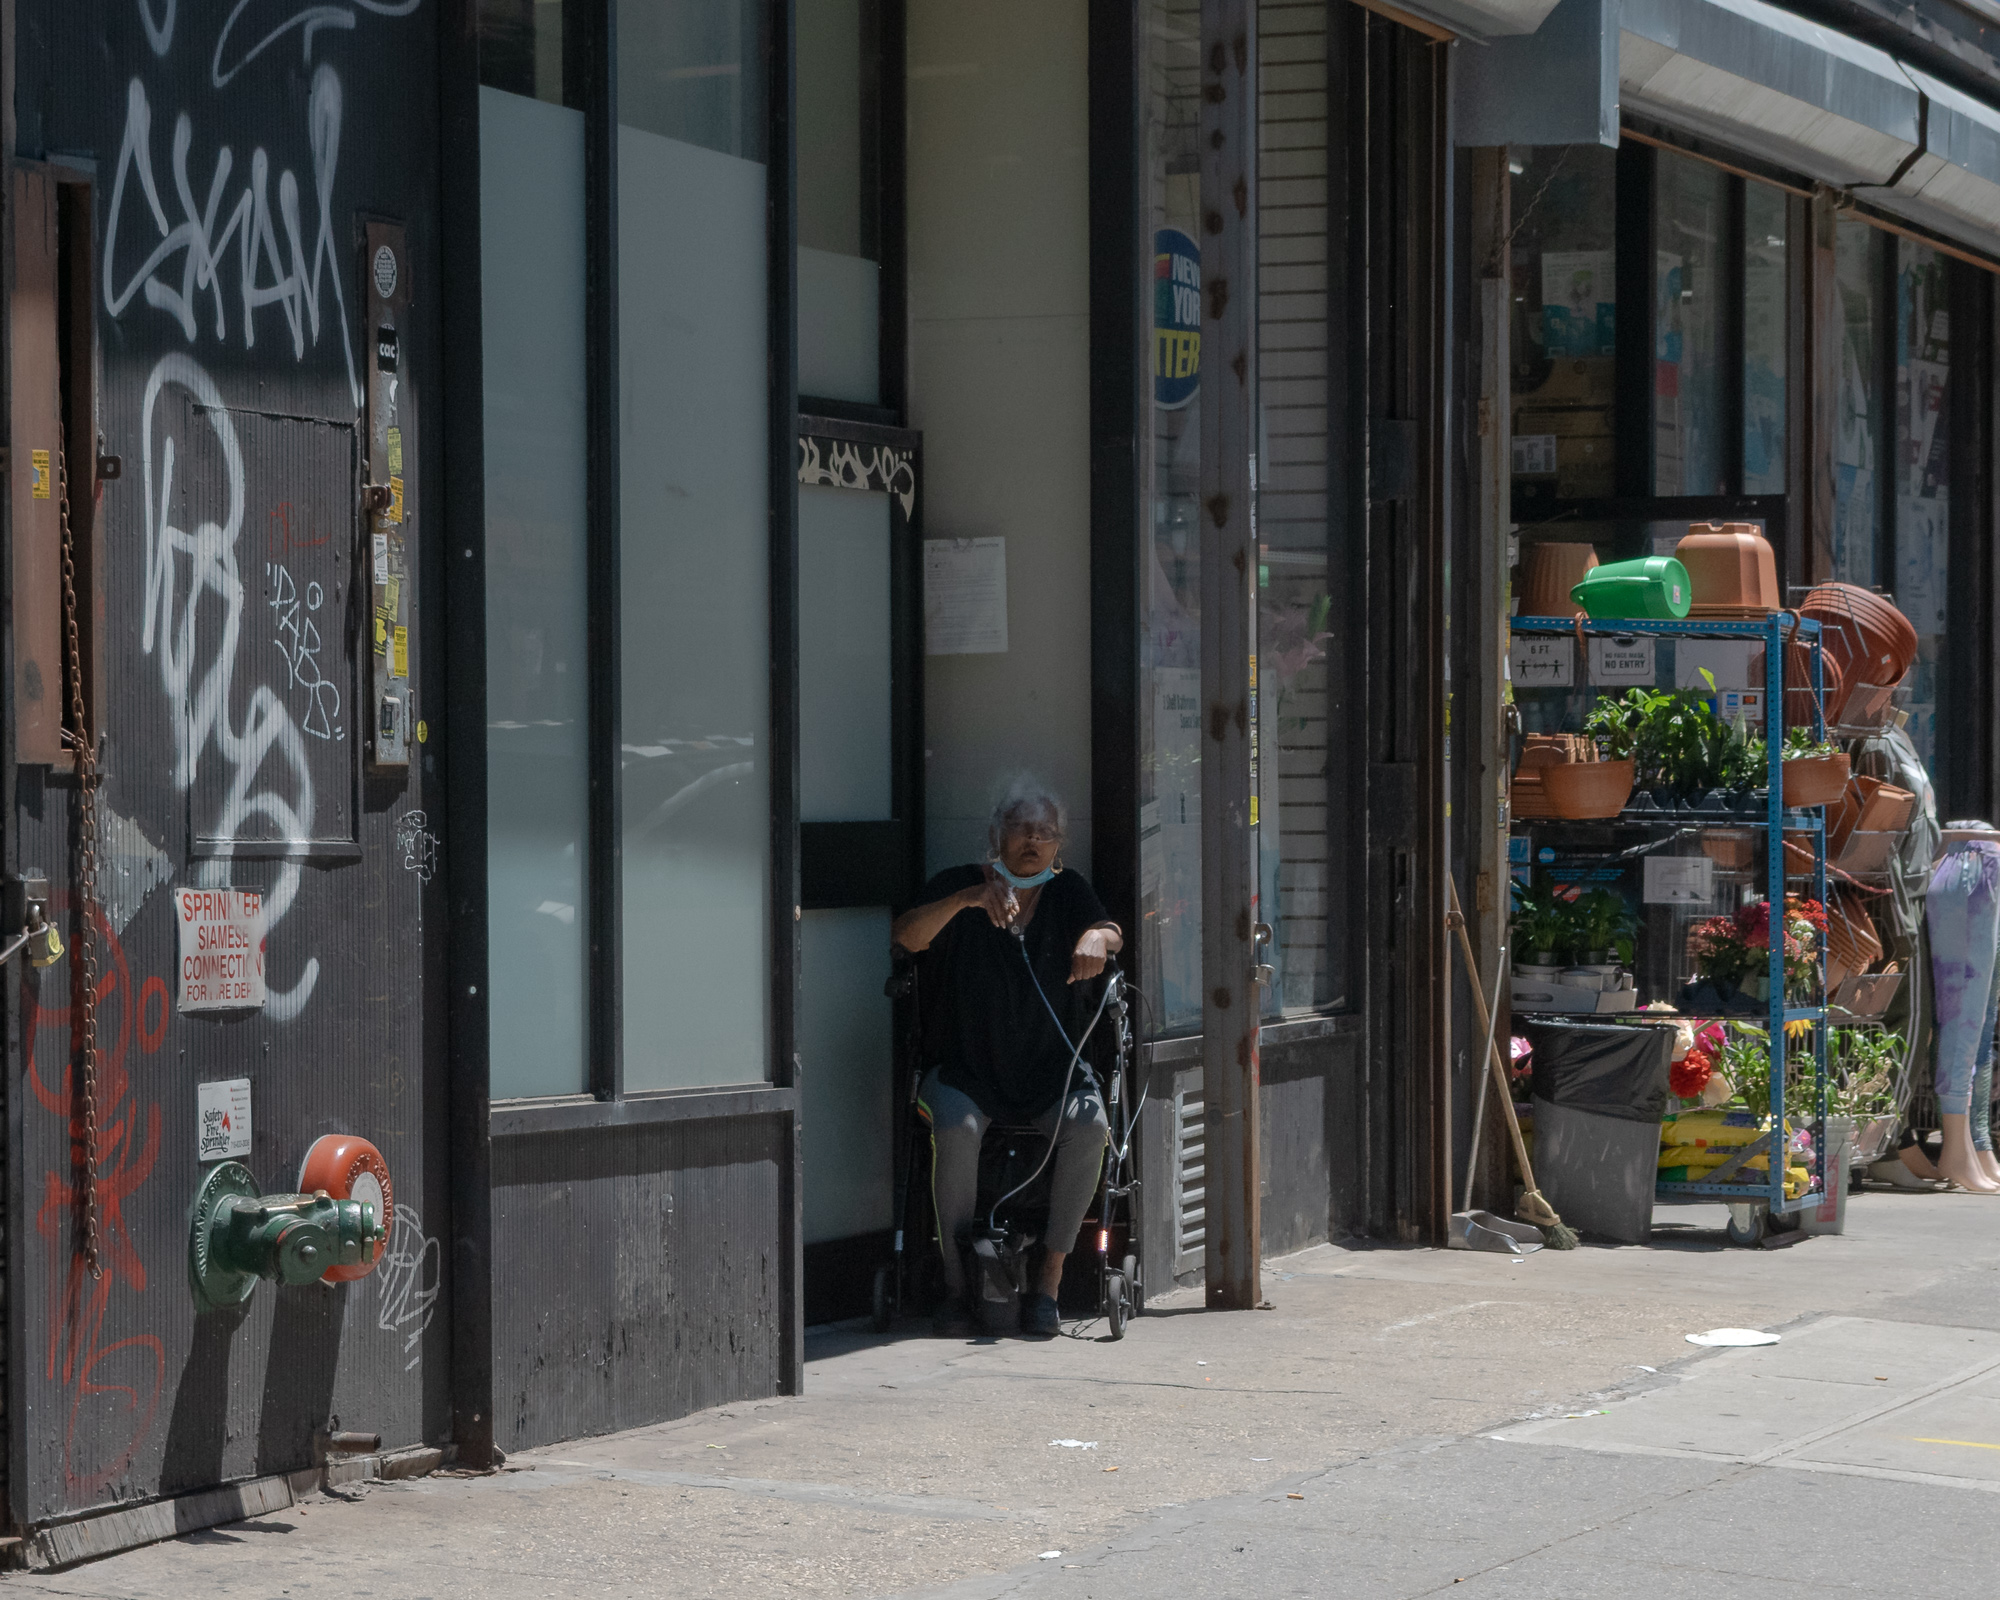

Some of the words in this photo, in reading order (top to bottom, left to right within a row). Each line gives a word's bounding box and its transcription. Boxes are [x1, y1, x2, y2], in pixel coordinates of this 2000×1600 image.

[1173, 284, 1200, 326] YOR
[379, 343, 396, 358] cac
[1154, 328, 1200, 379] TTER
[1530, 645, 1536, 655] 6
[1539, 645, 1550, 655] FT
[1605, 660, 1616, 669] NO
[1619, 660, 1646, 669] ENTRY
[198, 924, 249, 951] SIAMESE
[187, 984, 207, 1002] FOR
[209, 983, 232, 1001] RE
[235, 981, 258, 999] DEP
[203, 1107, 224, 1126] Safety
[206, 1123, 220, 1138] Fire
[201, 1132, 231, 1154] Sprinkler
